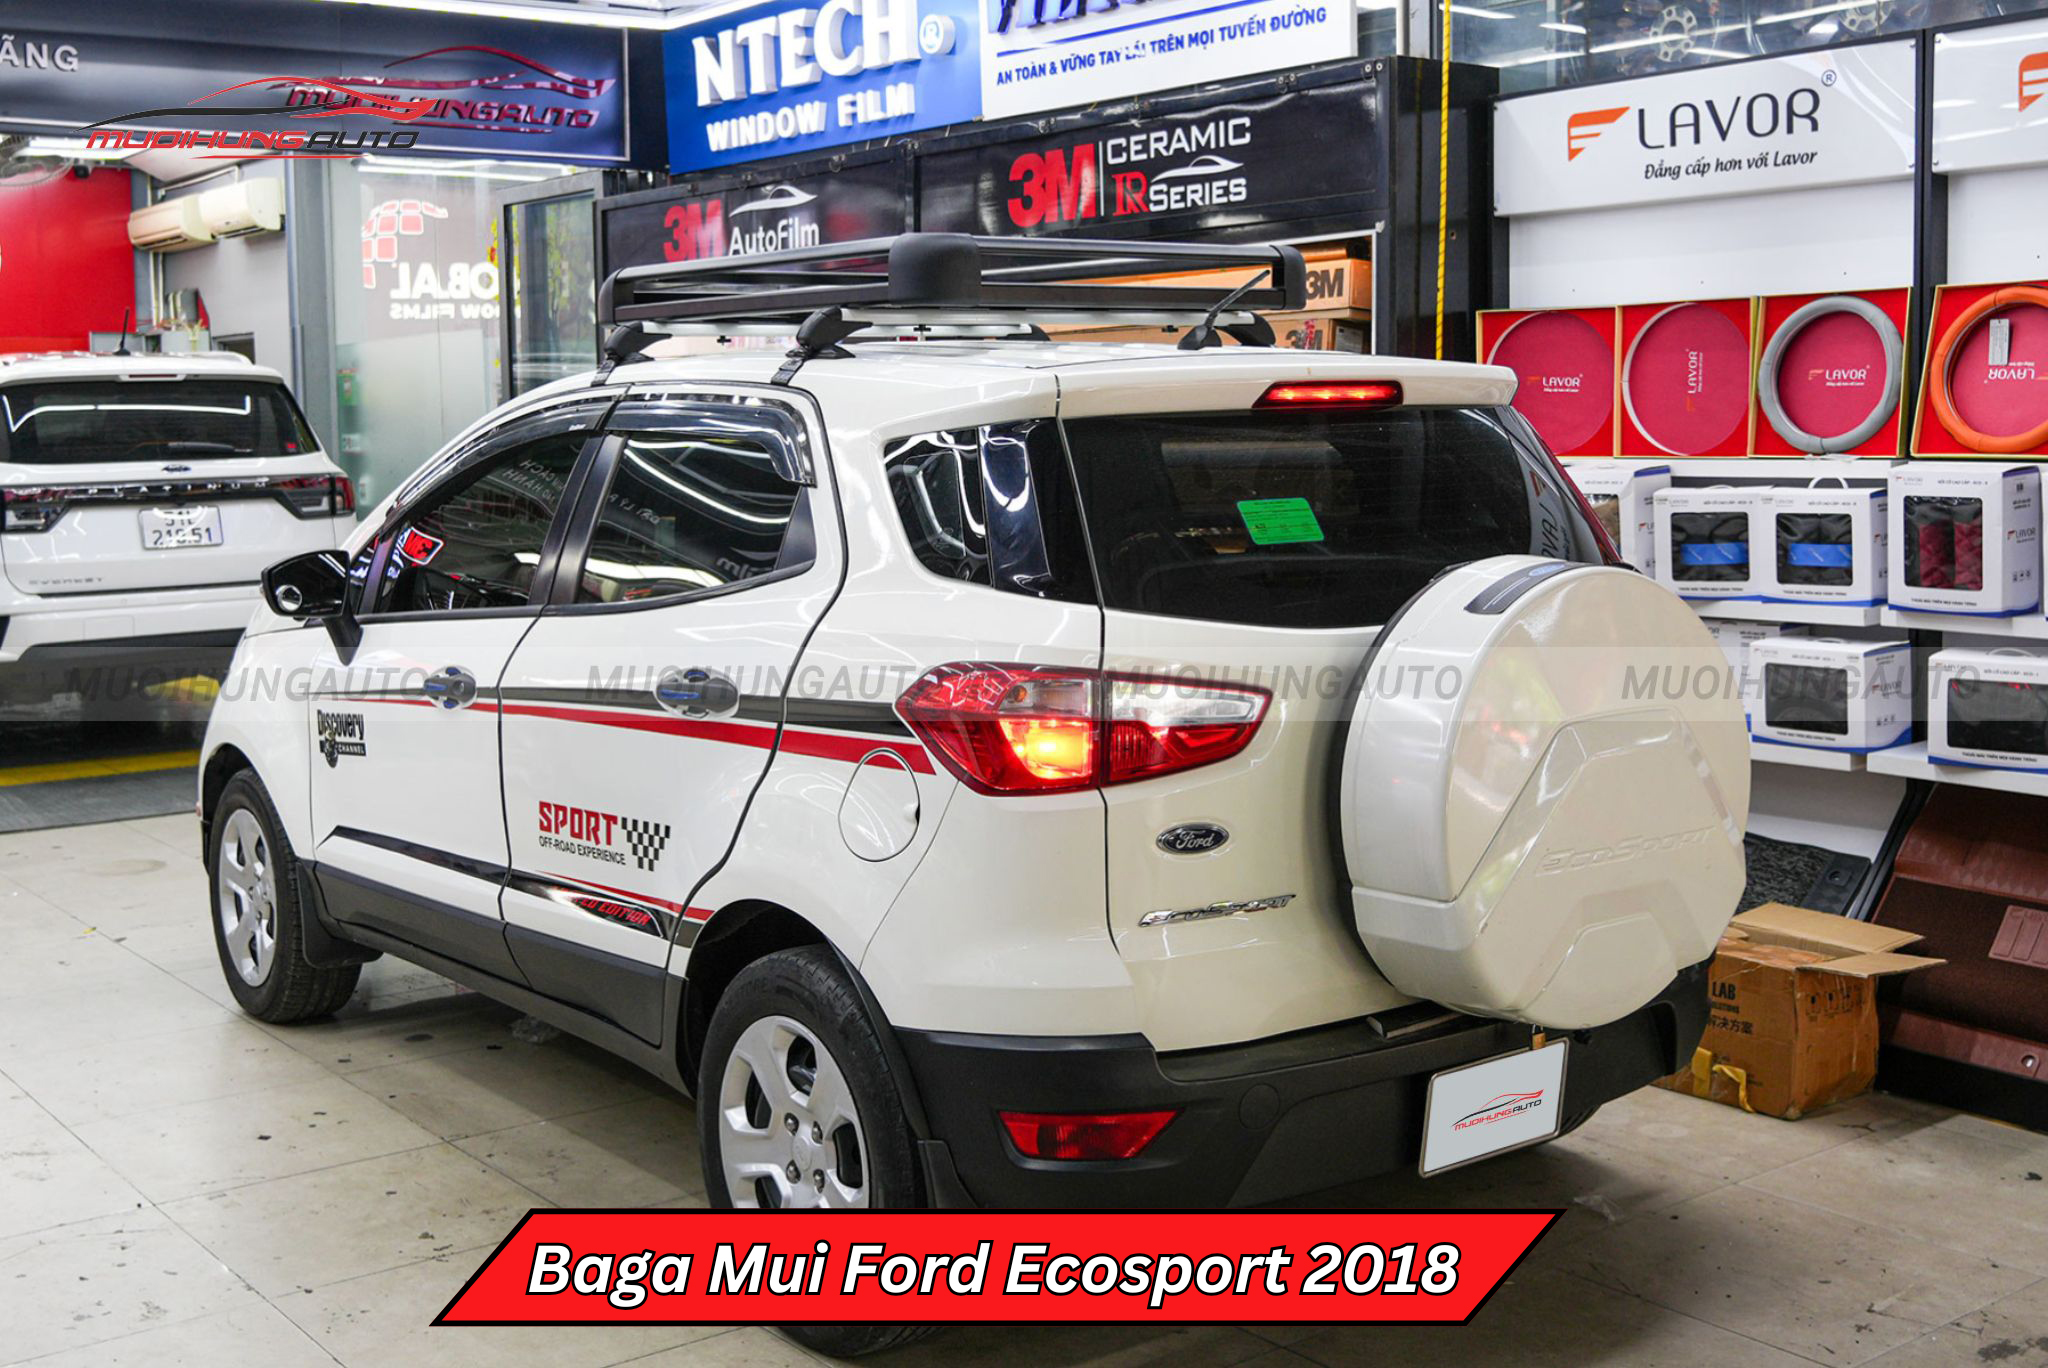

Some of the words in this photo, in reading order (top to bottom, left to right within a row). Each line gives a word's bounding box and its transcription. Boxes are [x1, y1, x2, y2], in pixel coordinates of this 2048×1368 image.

[692, 0, 921, 107] NTECH
[997, 72, 1013, 86] AN
[1015, 60, 1046, 81] TOÀN
[1049, 60, 1058, 75] &
[1060, 52, 1096, 73] VỮNG
[1099, 50, 1121, 66] TAY
[1150, 34, 1185, 54] TRÊN
[1188, 28, 1214, 50] MỌI
[1219, 14, 1266, 41] TUYẾN
[1271, 5, 1327, 31] ĐƯỜNG
[706, 101, 827, 152] WINDOW
[838, 82, 915, 128] FILM
[1638, 88, 1820, 150] LAVOR
[1007, 143, 1097, 227] 3M
[1106, 116, 1252, 165] CERAMIC
[1644, 159, 1681, 180] Đẳng
[1685, 156, 1711, 177] cấp
[1714, 157, 1743, 173] hơn
[1746, 152, 1769, 170] với
[1773, 151, 1818, 167] Lavor
[663, 200, 724, 262] 3M
[728, 216, 821, 257] AutoFilm
[1305, 268, 1344, 300] 3M
[1542, 376, 1581, 388] LAVOR
[1687, 350, 1699, 395] LAVOR
[1825, 368, 1867, 381] LAVOR
[1988, 368, 2035, 380] LAVOR
[538, 801, 618, 846] SPORT
[1176, 829, 1215, 849] Ford
[539, 835, 576, 854] OFF-ROAD
[577, 844, 627, 866] EXPERIENCE
[1712, 981, 1736, 1001] LAB
